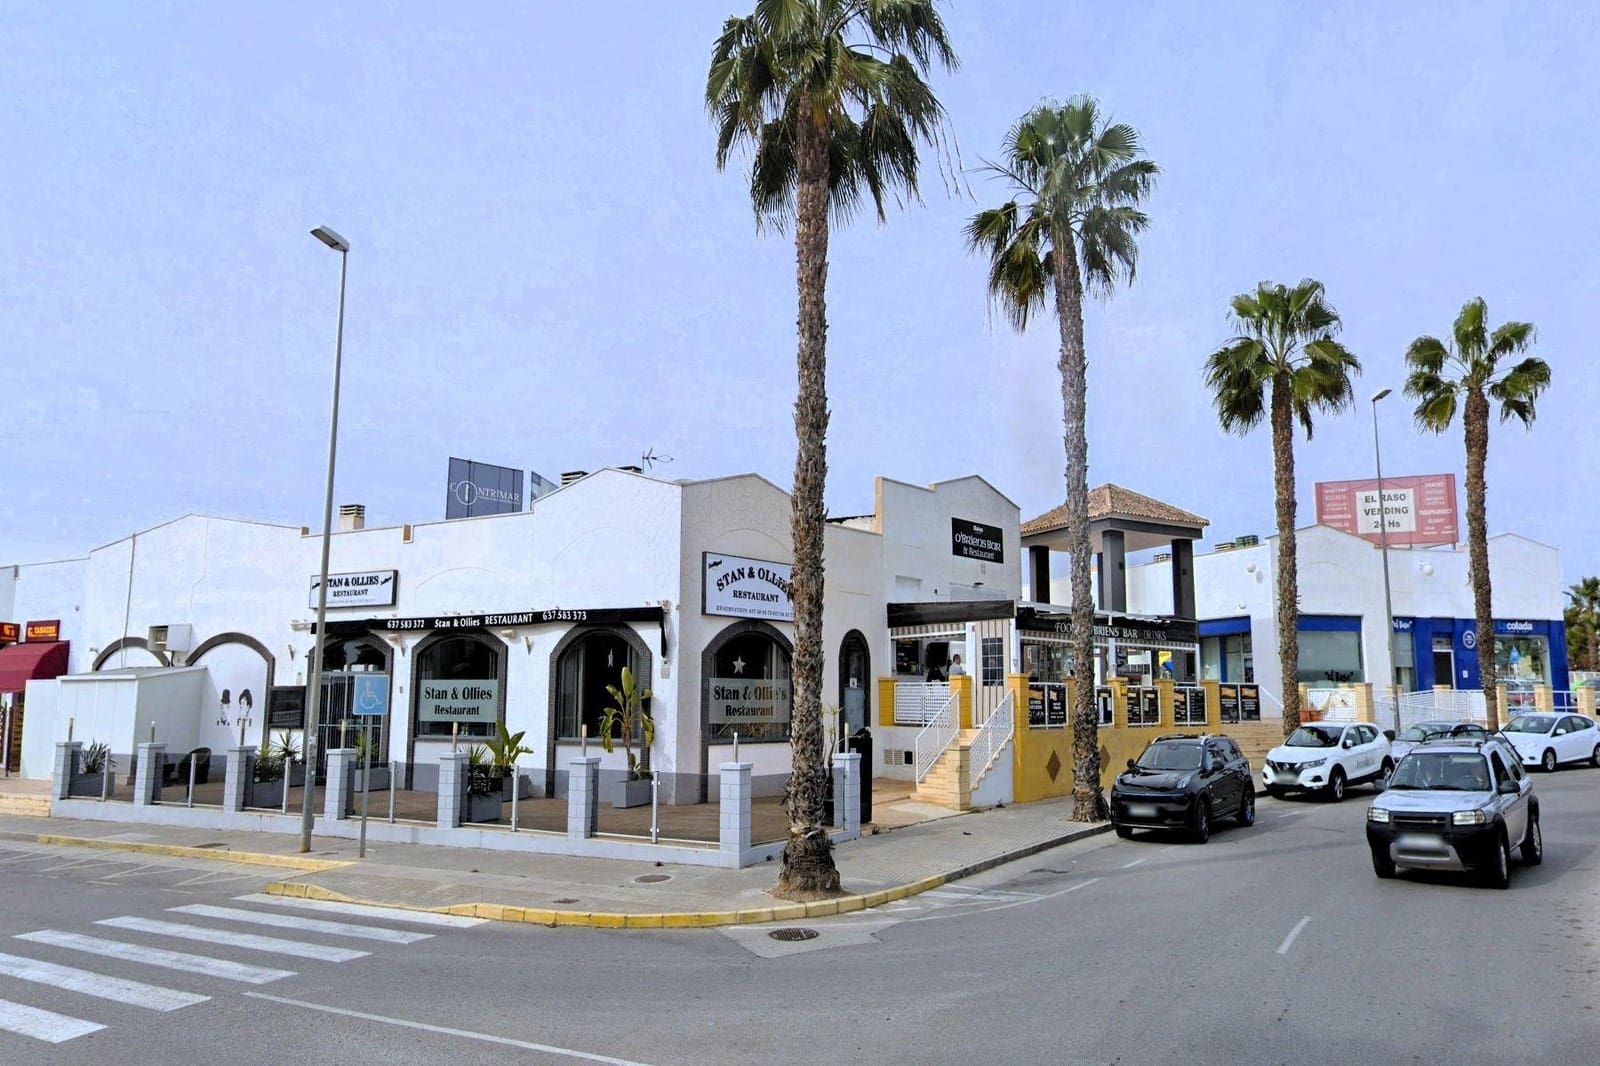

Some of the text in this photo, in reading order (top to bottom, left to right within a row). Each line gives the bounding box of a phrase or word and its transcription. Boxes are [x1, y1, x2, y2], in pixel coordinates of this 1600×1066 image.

[327, 577, 343, 588] TAN
[344, 578, 350, 587] &
[351, 575, 379, 586] OLLIES
[716, 567, 745, 592] STAN
[747, 566, 755, 579] &
[333, 589, 369, 598] RESTAURANT
[732, 589, 779, 603] RESTAURANT
[387, 619, 399, 629] 637
[453, 618, 459, 627] &
[484, 613, 533, 625] RESTAURANT
[542, 610, 556, 621] 637
[1055, 622, 1075, 633] FOO
[1093, 625, 1119, 638] BRIENS
[1122, 627, 1138, 639] BAR
[424, 686, 493, 700] Stan & Ollies
[713, 685, 740, 701] Stan
[742, 686, 752, 700] &
[434, 704, 480, 716] Restaurant
[725, 704, 774, 717] Restaurant
